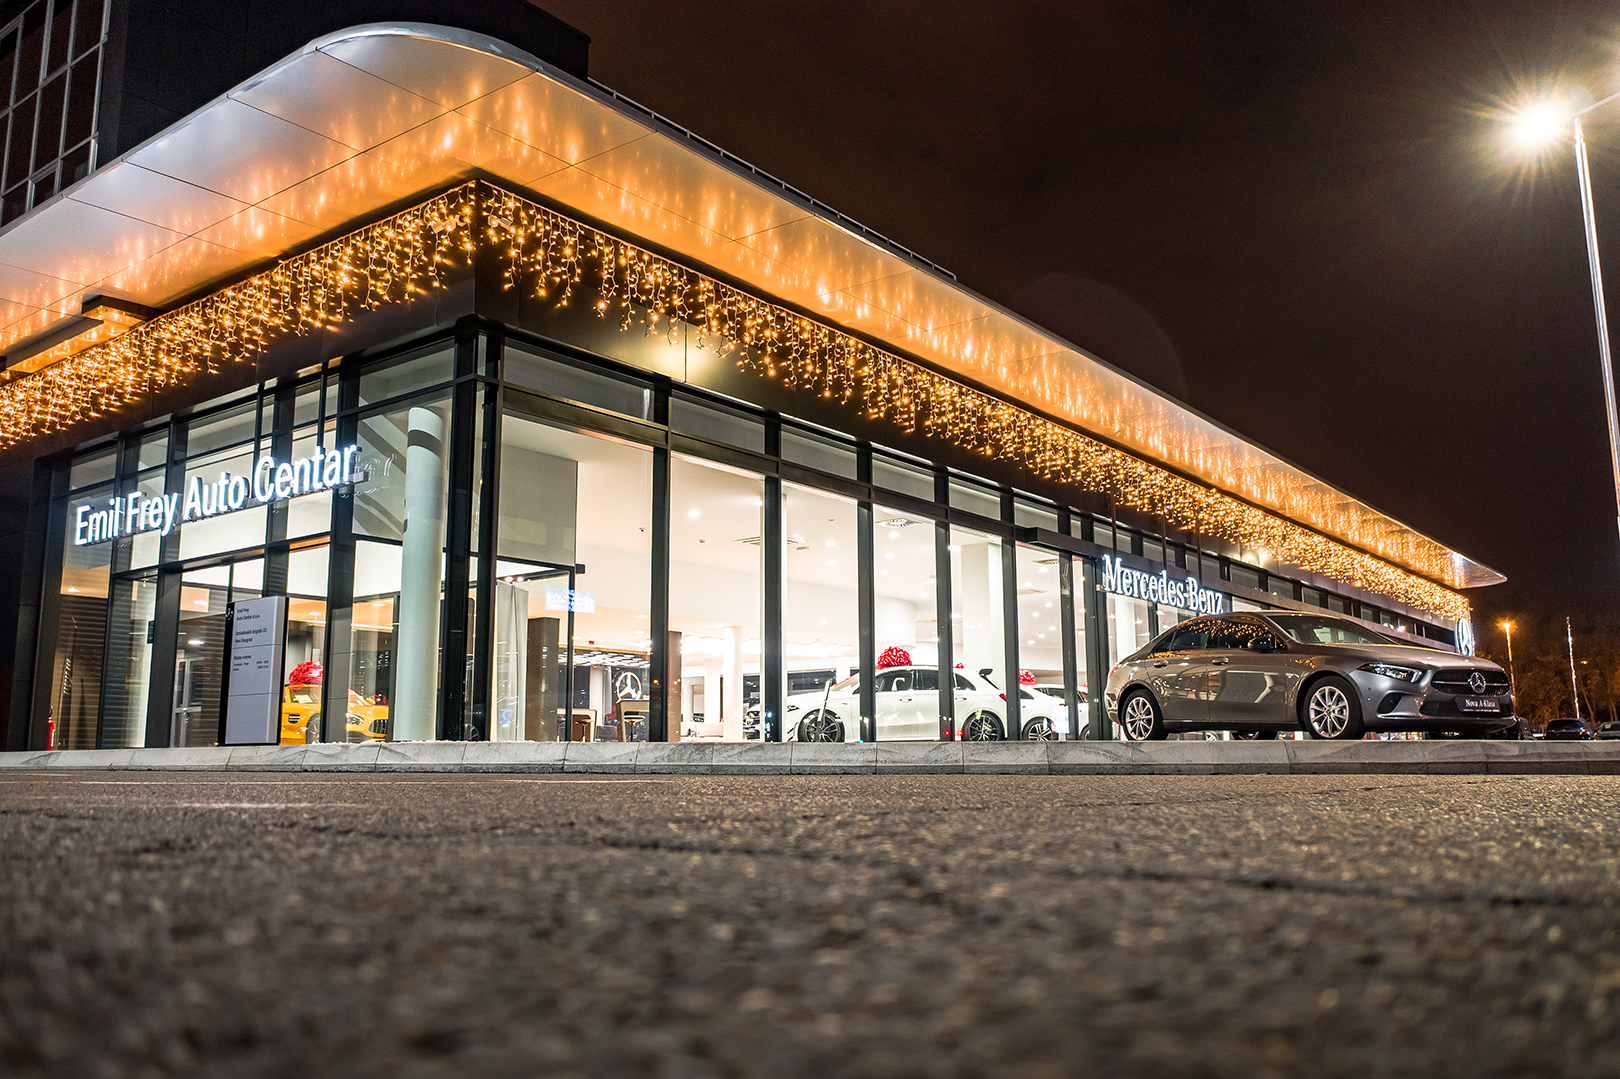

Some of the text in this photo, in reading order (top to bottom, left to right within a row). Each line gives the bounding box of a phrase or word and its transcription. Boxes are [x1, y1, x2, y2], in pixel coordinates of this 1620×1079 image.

[75, 444, 359, 547] Emil Frey Auto Centar
[1103, 553, 1224, 615] Mercedes-Benz
[1465, 699, 1478, 707] Nova
